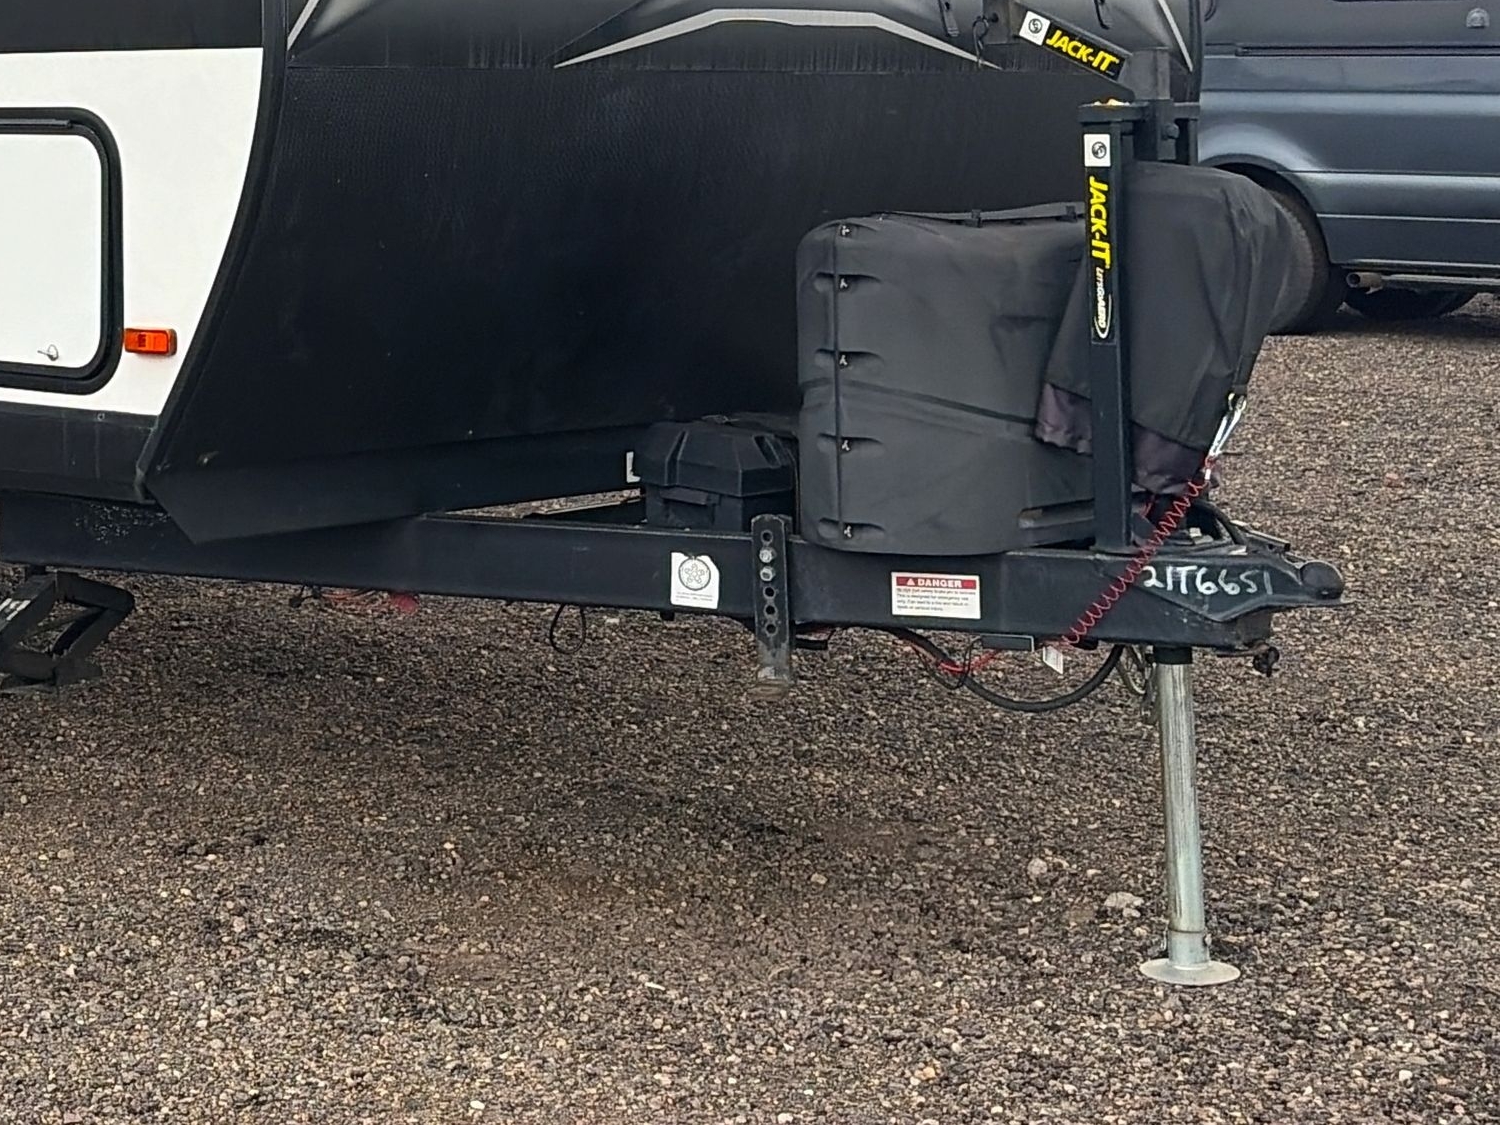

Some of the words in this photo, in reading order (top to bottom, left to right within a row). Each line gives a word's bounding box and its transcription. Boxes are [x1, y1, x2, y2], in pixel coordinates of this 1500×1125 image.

[1046, 29, 1119, 71] JACK-IT
[1089, 176, 1110, 269] JACK-IT
[917, 578, 962, 587] DANGER
